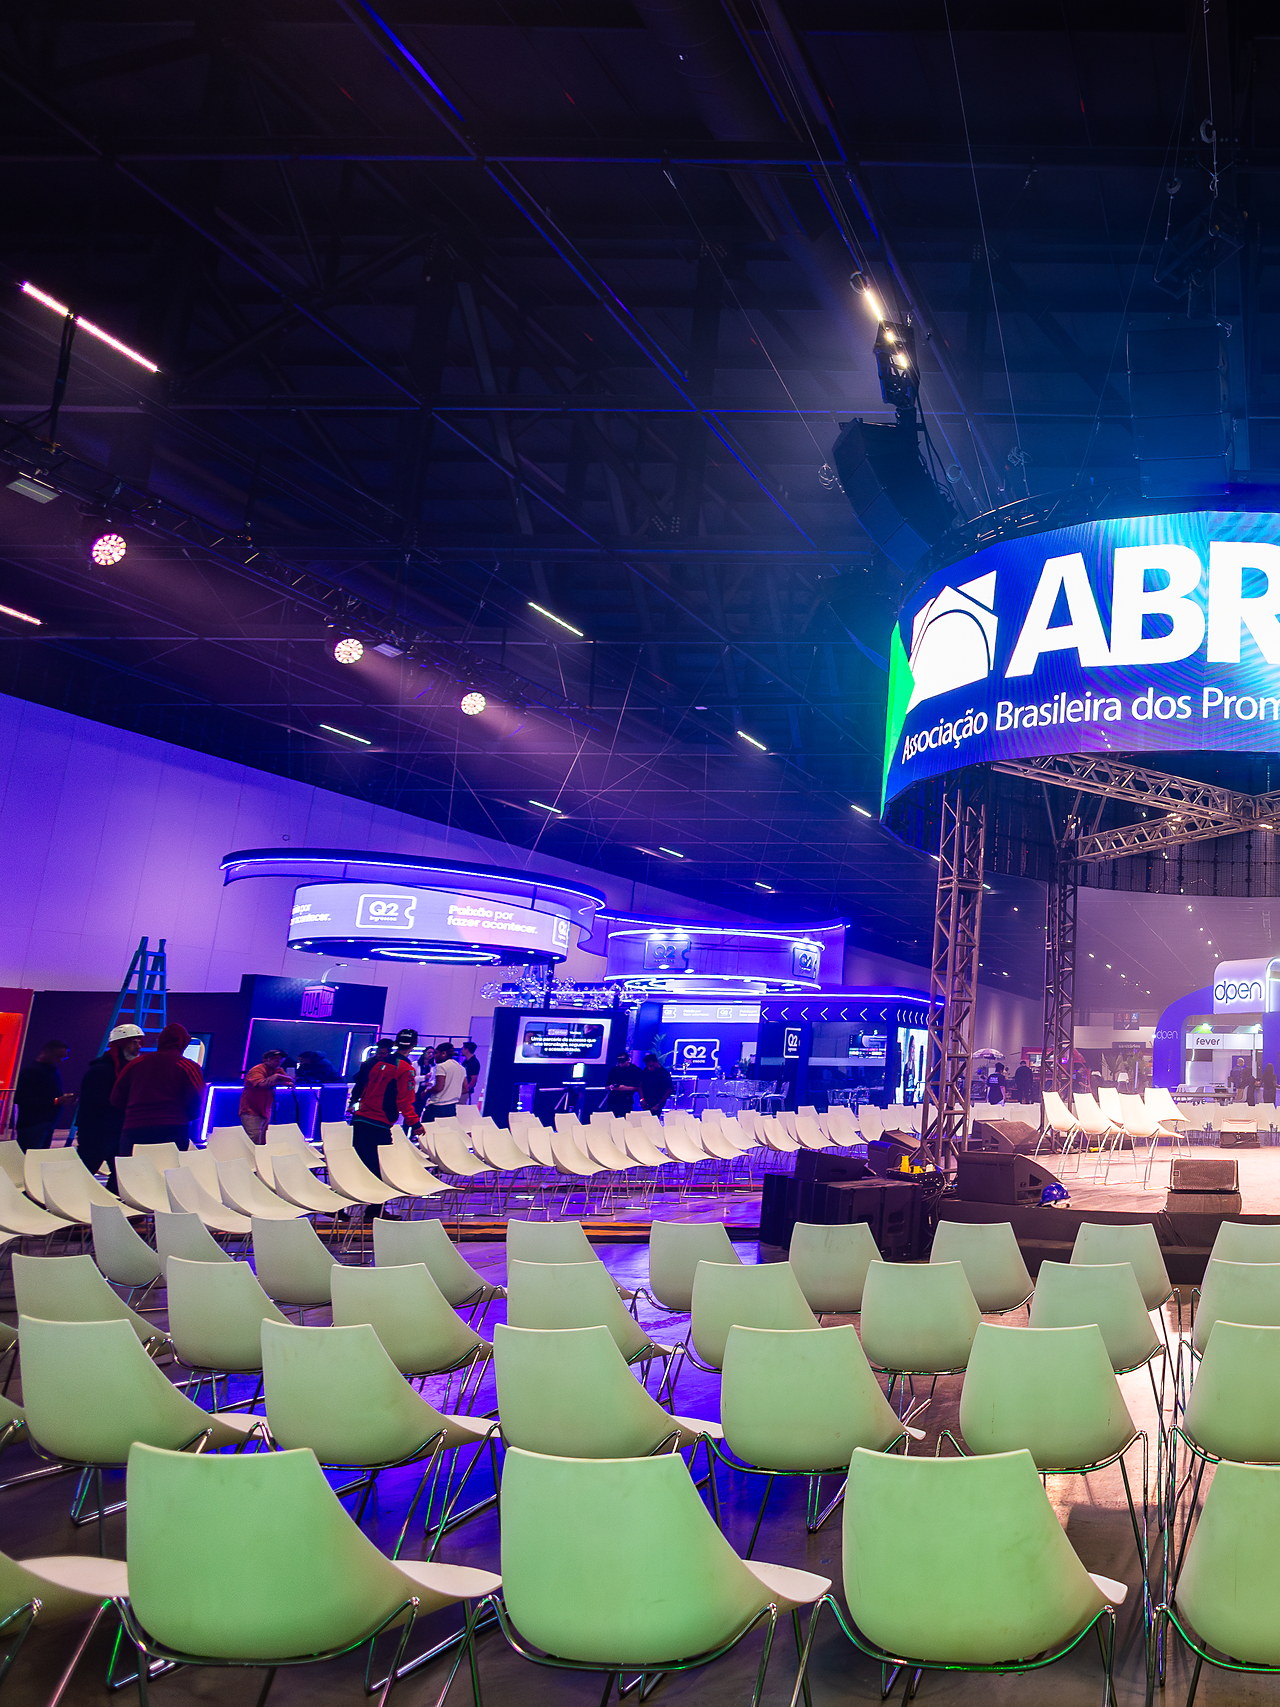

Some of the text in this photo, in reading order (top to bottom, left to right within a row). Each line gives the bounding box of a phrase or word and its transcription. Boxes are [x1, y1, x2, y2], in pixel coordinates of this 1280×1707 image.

[902, 707, 988, 764] Associação
[996, 691, 1122, 731] Brasileira
[1131, 687, 1192, 720] dos
[369, 900, 399, 917] Q2
[494, 910, 515, 921] por
[447, 914, 539, 935] fazer acontecer.
[653, 943, 677, 960] Q2
[1196, 1037, 1220, 1046] fever
[683, 1044, 707, 1060] Q2
